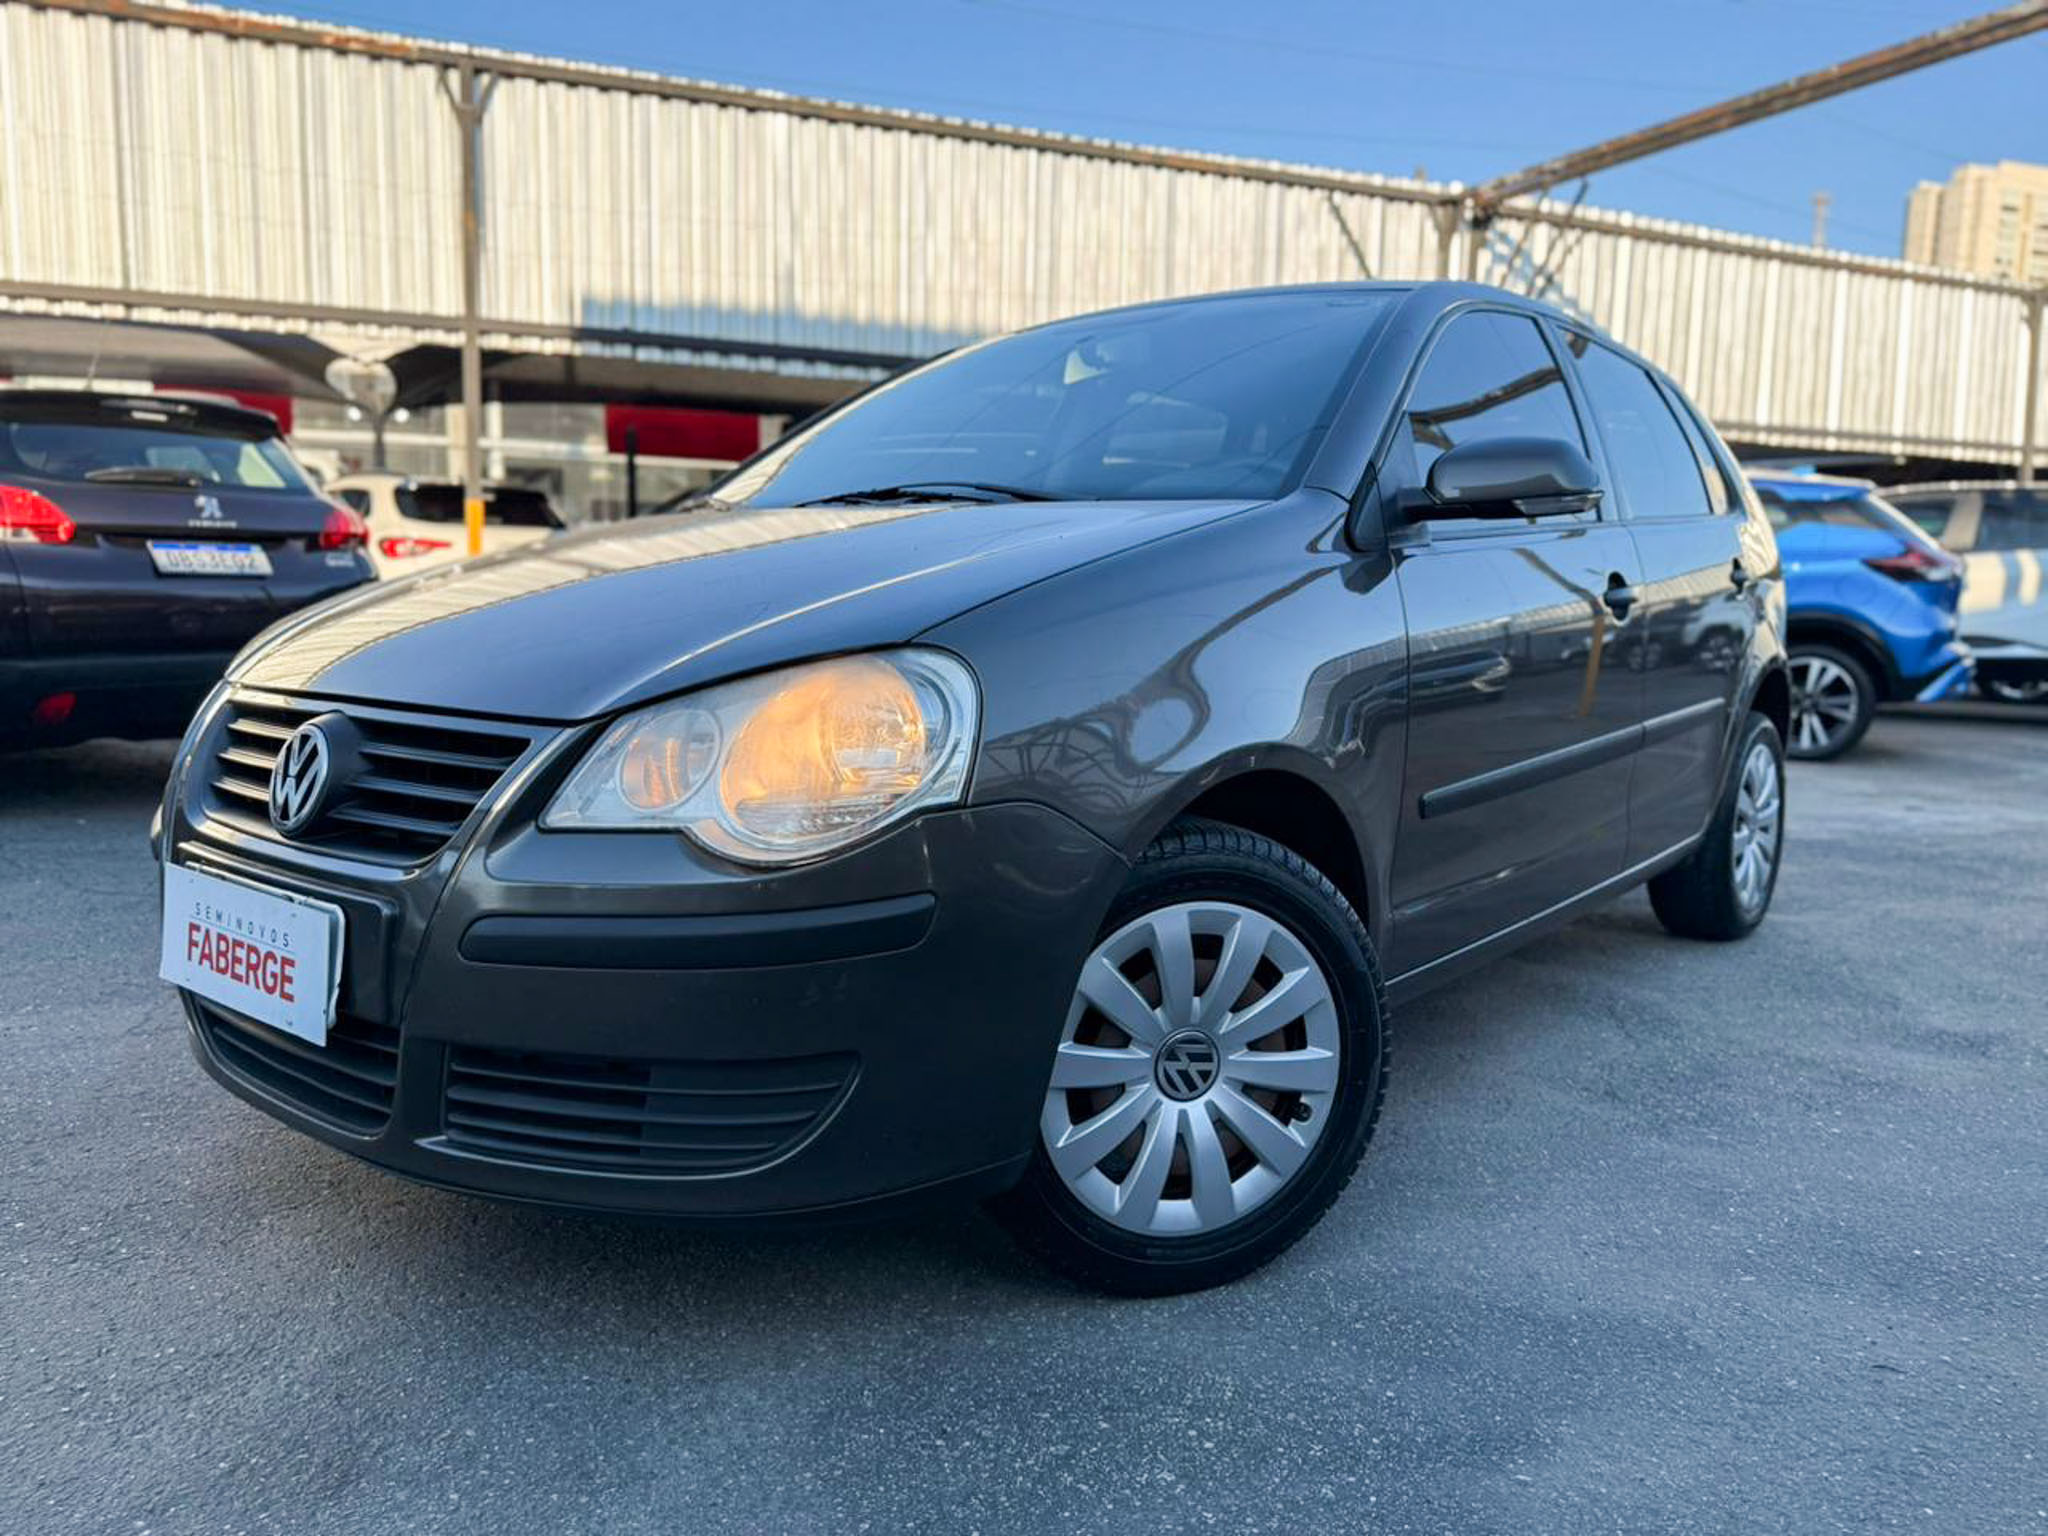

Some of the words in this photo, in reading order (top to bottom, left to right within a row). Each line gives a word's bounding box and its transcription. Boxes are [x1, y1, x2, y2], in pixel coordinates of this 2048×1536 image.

[270, 724, 329, 833] VW
[187, 921, 296, 1003] FABERGE
[195, 902, 290, 948] SEMINOVOS
